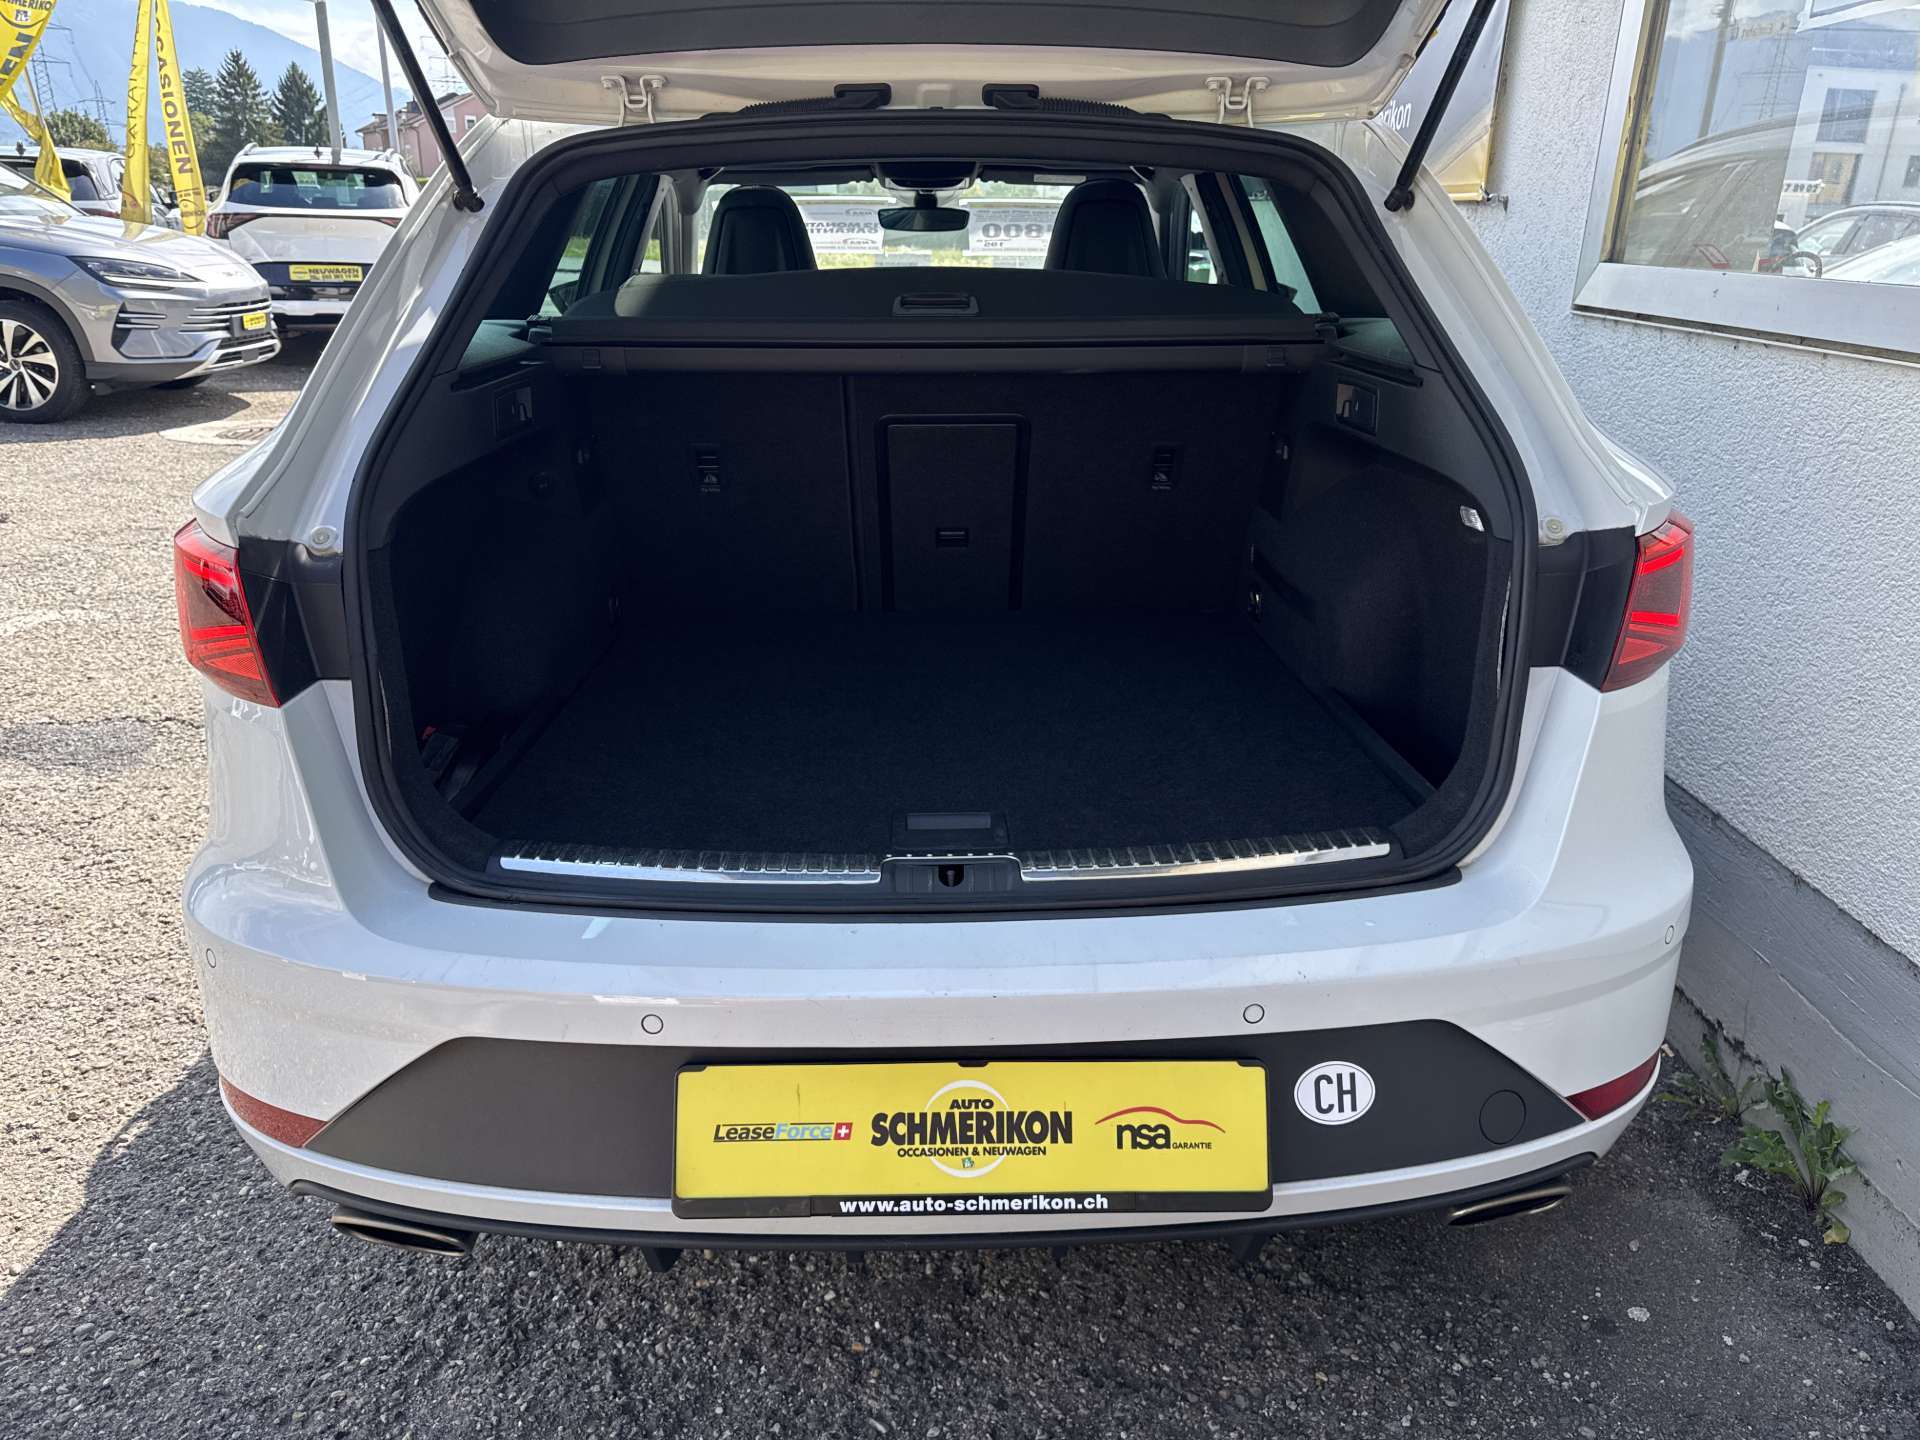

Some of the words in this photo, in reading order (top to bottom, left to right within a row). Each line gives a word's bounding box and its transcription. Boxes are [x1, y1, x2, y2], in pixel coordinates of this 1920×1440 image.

[1314, 1072, 1358, 1114] CH
[950, 1098, 994, 1110] AUTO
[713, 1123, 833, 1142] LeaseForce
[871, 1110, 1073, 1147] SCHMERIKON
[1116, 1123, 1171, 1150] nsa
[1172, 1142, 1213, 1150] GARANTIE
[897, 1147, 969, 1158] OCCASIONEN
[971, 1147, 981, 1157] &
[983, 1146, 1047, 1157] NEUWAGEN
[839, 1193, 1109, 1214] www.auto-schmerikon.ch
